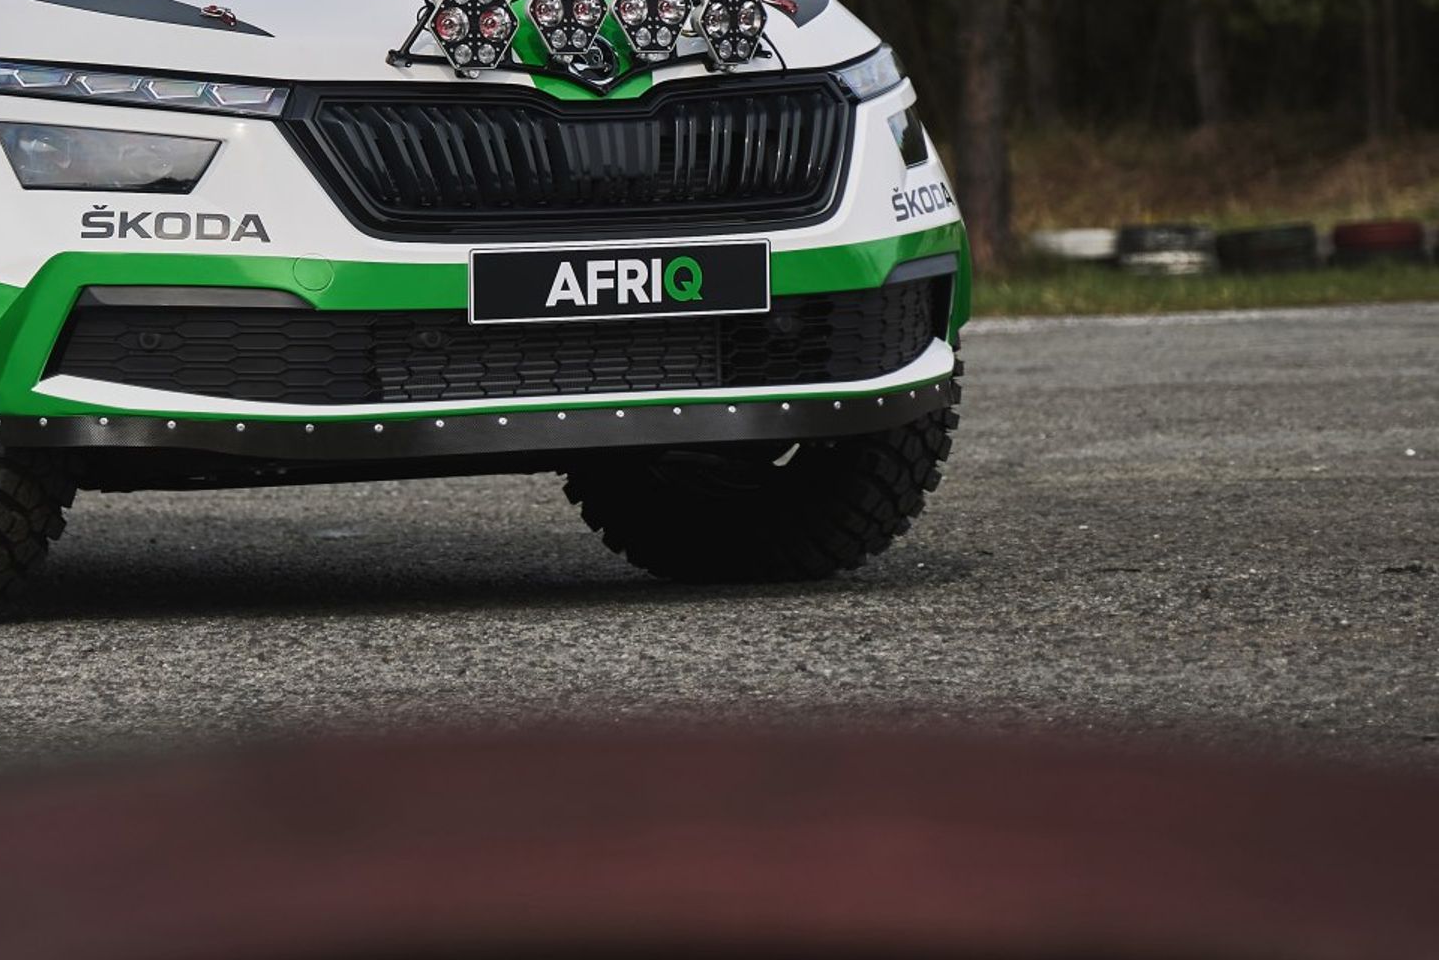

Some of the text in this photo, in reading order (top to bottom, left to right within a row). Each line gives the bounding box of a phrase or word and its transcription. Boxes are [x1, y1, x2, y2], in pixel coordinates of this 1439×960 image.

[891, 182, 956, 222] ŠKODA
[80, 204, 271, 243] ŠKODA
[544, 254, 703, 307] AFRIQ
